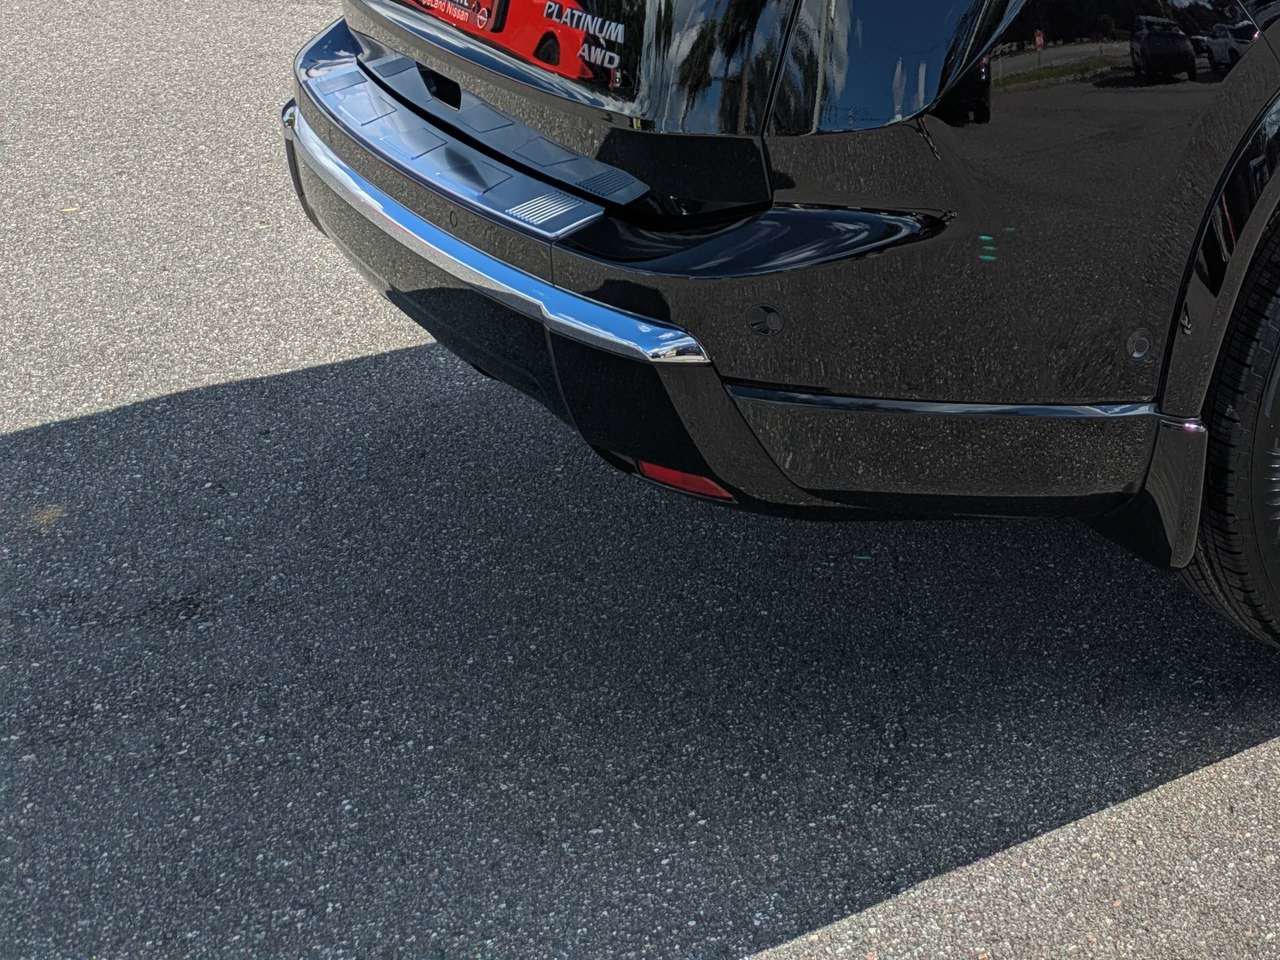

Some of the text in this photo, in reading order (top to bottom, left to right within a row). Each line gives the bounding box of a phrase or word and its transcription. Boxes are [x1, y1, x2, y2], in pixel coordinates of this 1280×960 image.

[446, 2, 469, 22] Nissan
[544, 0, 625, 44] PLATINUM
[576, 43, 621, 69] AWD
